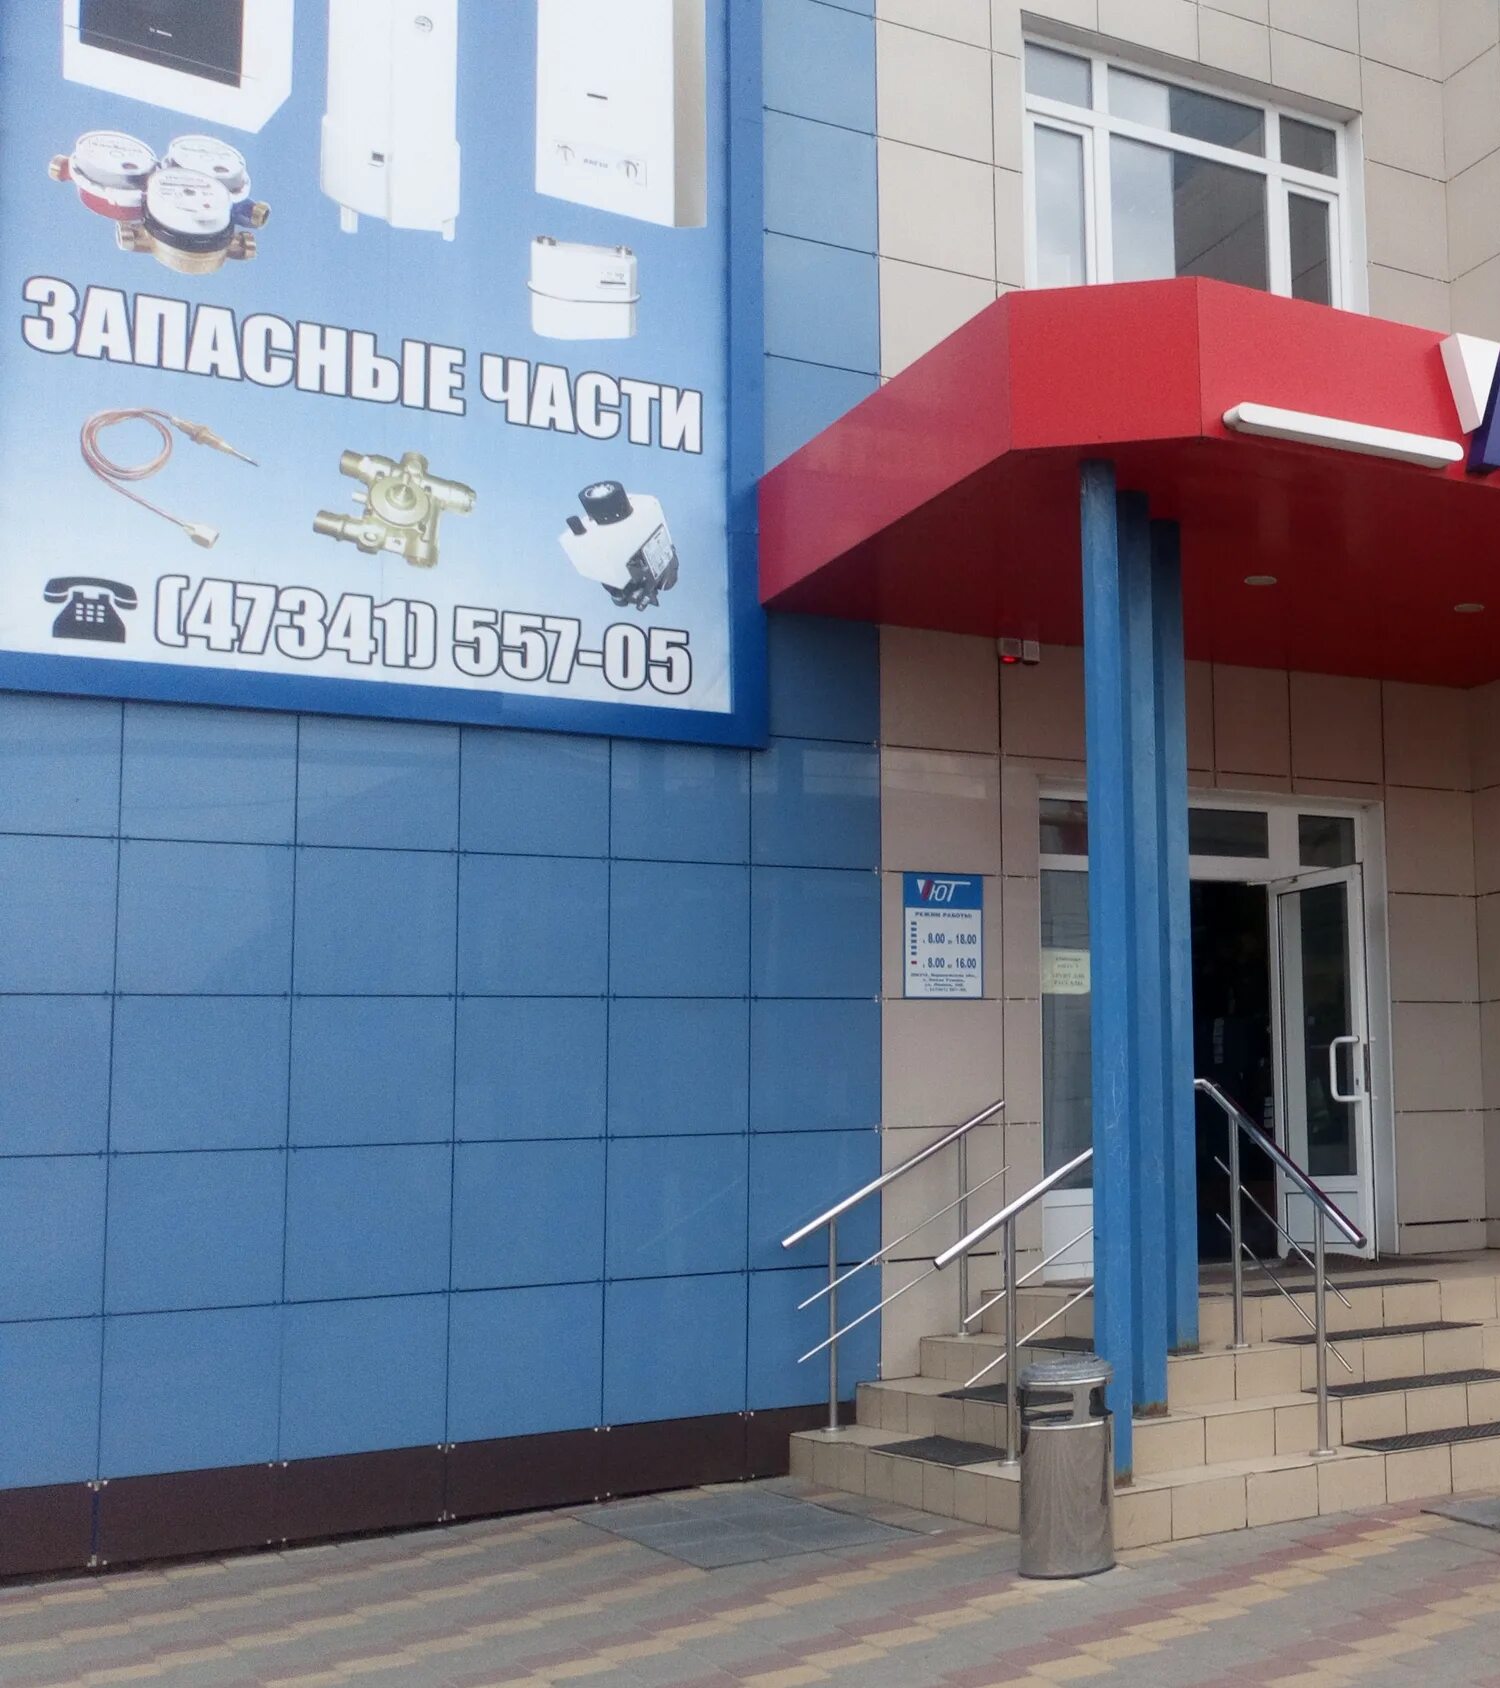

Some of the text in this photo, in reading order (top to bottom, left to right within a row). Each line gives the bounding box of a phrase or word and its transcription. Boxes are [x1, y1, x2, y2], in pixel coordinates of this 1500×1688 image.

[22, 276, 703, 454] ЗАПАСНЫЕ ЧАСТИ
[153, 573, 693, 696] (47341) 557-05
[927, 957, 946, 968] 8.00
[955, 957, 977, 969] 16.00
[955, 934, 977, 945] 18.00
